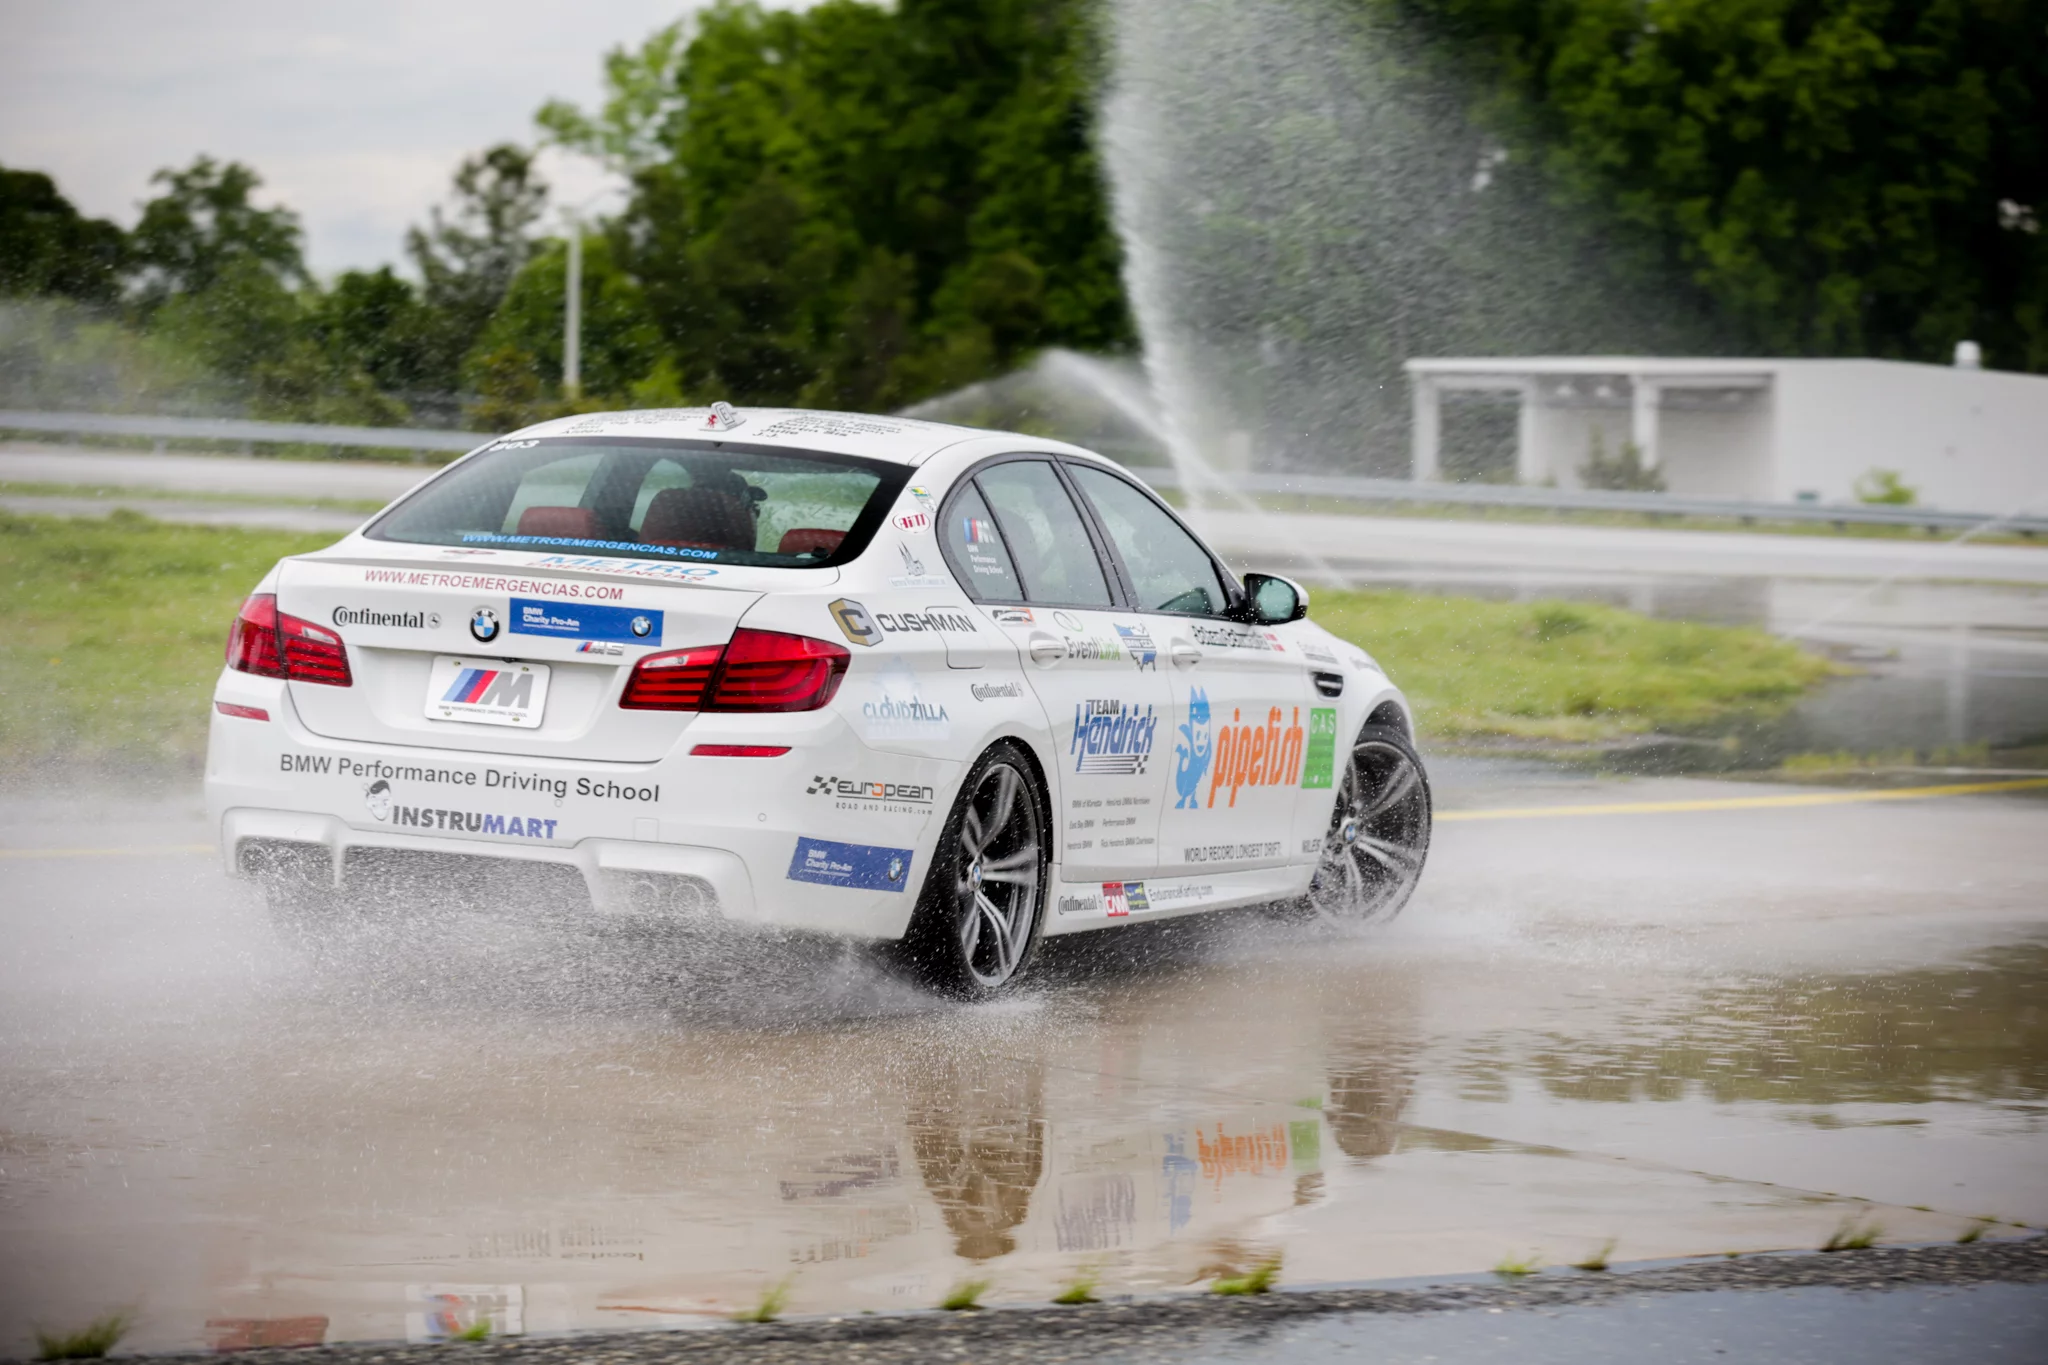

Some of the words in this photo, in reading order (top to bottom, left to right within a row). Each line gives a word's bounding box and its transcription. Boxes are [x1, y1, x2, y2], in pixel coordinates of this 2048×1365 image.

[463, 534, 717, 560] WWW.METROEMERGENCIAS.COM
[541, 556, 719, 577] METRO
[365, 570, 624, 601] WWW.METROEMERGENCIAS.COM
[332, 606, 424, 628] Continental
[523, 607, 543, 615] BMW
[523, 614, 550, 625] Charity
[551, 617, 580, 626] Pro-Am
[876, 613, 978, 632] CUSHMAN
[1064, 636, 1120, 661] EventLink
[971, 683, 1018, 702] Continental
[863, 698, 949, 721] CLOUDZILLA
[1086, 700, 1119, 715] TEAM
[1311, 713, 1335, 734] CAS
[1070, 704, 1157, 772] Hendrick
[1207, 706, 1303, 808] pipefish
[280, 753, 332, 774] BMW
[338, 758, 477, 785] Performance
[485, 769, 567, 798] Driving
[576, 777, 660, 802] School
[836, 802, 858, 810] ROAD
[863, 803, 879, 812] AND
[392, 805, 557, 839] INSTRUMART
[807, 849, 827, 859] BMW
[1184, 847, 1207, 863] WORLD
[1208, 844, 1234, 861] RECORD
[1236, 842, 1263, 860] LONGEST
[805, 858, 829, 871] Charity
[1058, 894, 1097, 916] Continental
